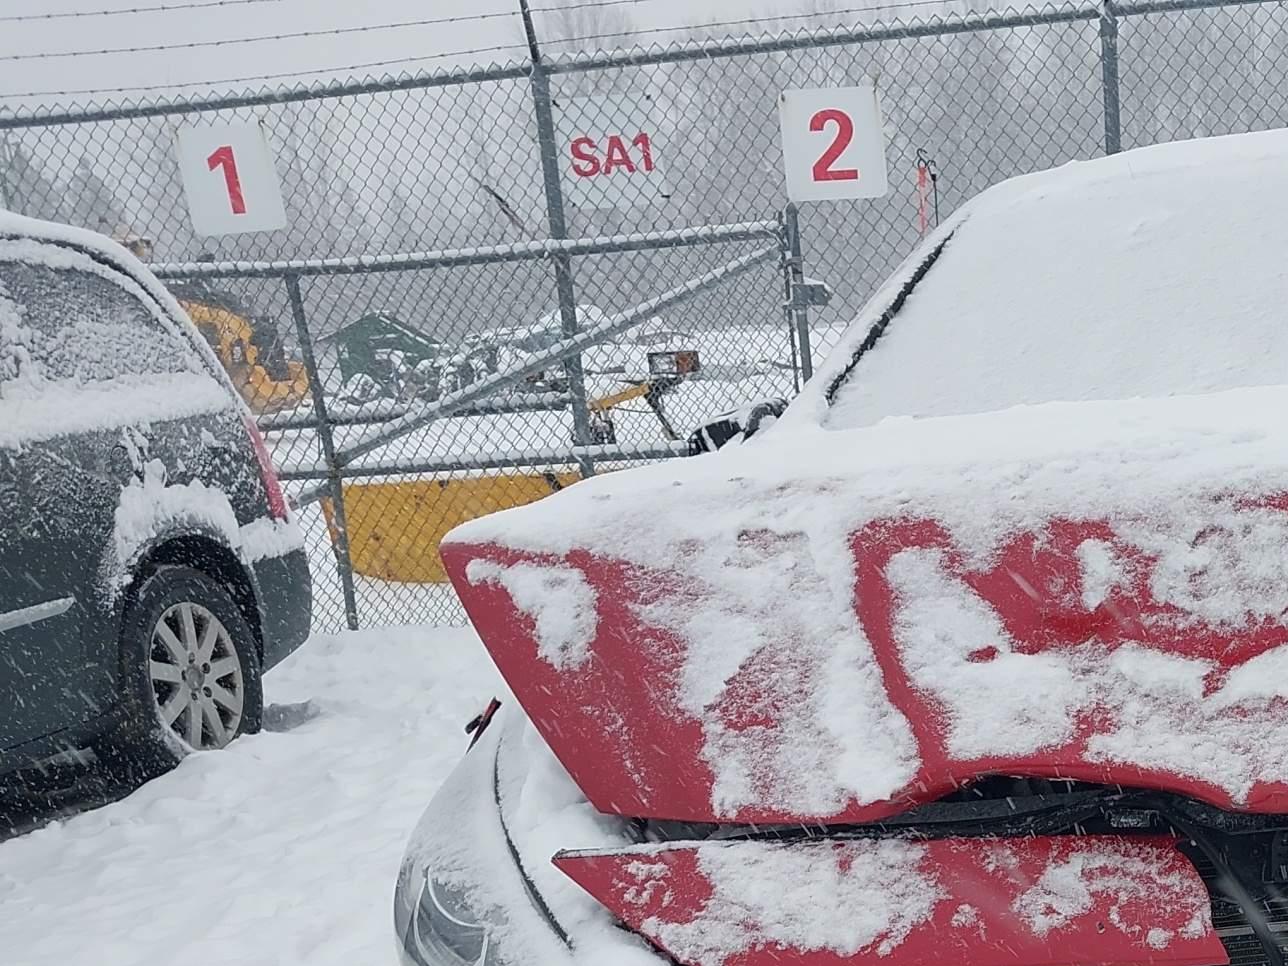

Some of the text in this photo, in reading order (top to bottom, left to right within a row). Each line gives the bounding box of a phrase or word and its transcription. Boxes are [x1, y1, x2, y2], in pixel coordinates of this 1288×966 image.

[207, 145, 246, 214] 1
[570, 132, 654, 177] SA1
[809, 109, 858, 181] 2
